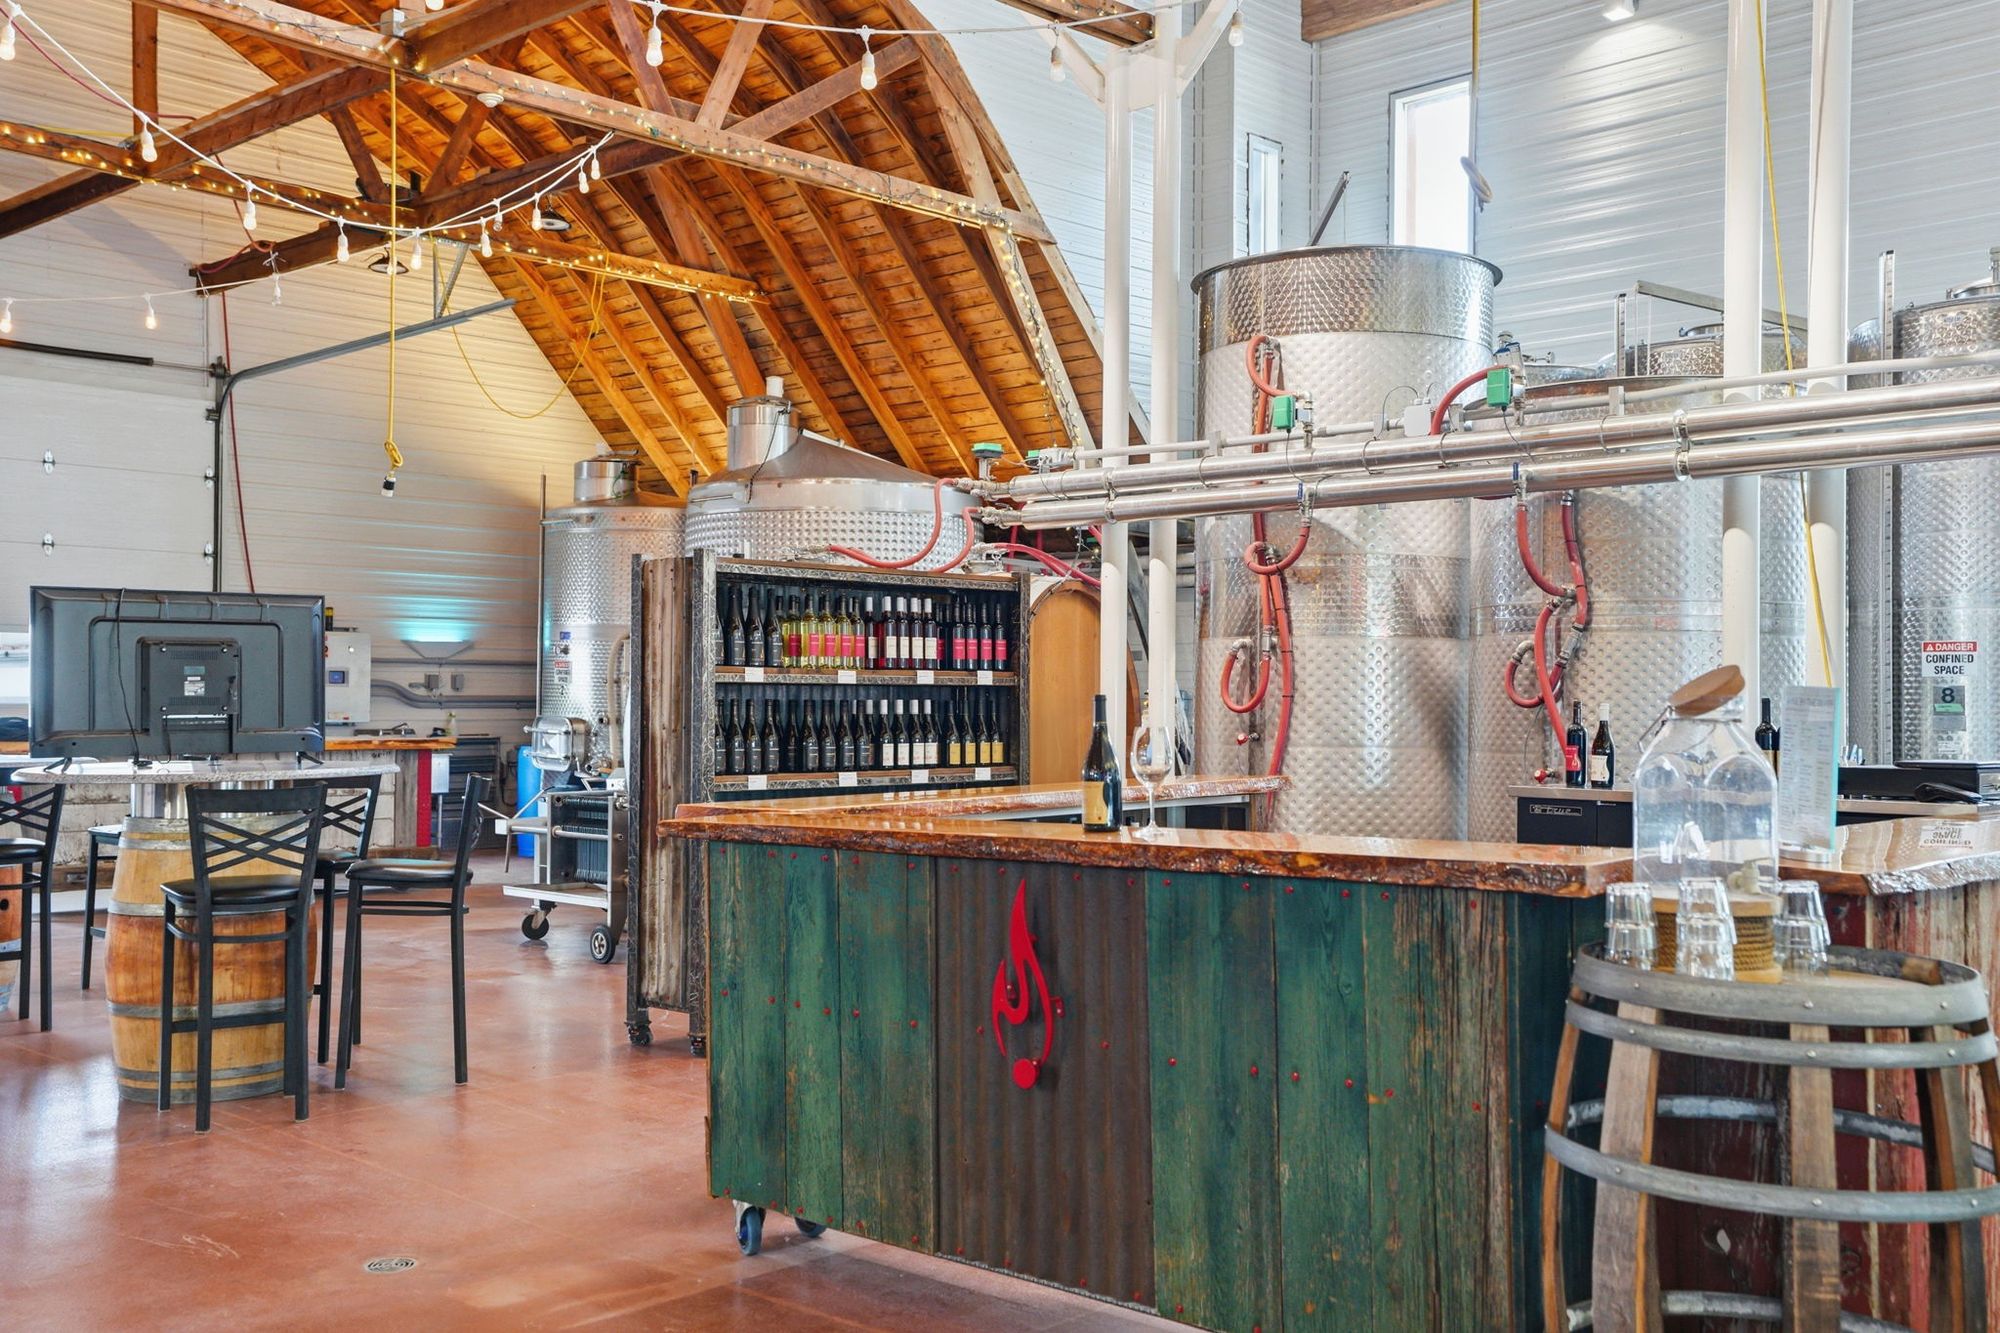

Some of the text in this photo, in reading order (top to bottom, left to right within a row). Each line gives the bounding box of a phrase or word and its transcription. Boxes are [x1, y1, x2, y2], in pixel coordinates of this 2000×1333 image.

[1935, 643, 1974, 651] DANGER
[1926, 654, 1974, 663] CONFINED
[1934, 666, 1965, 675] SPACE
[1941, 687, 1955, 703] 8
